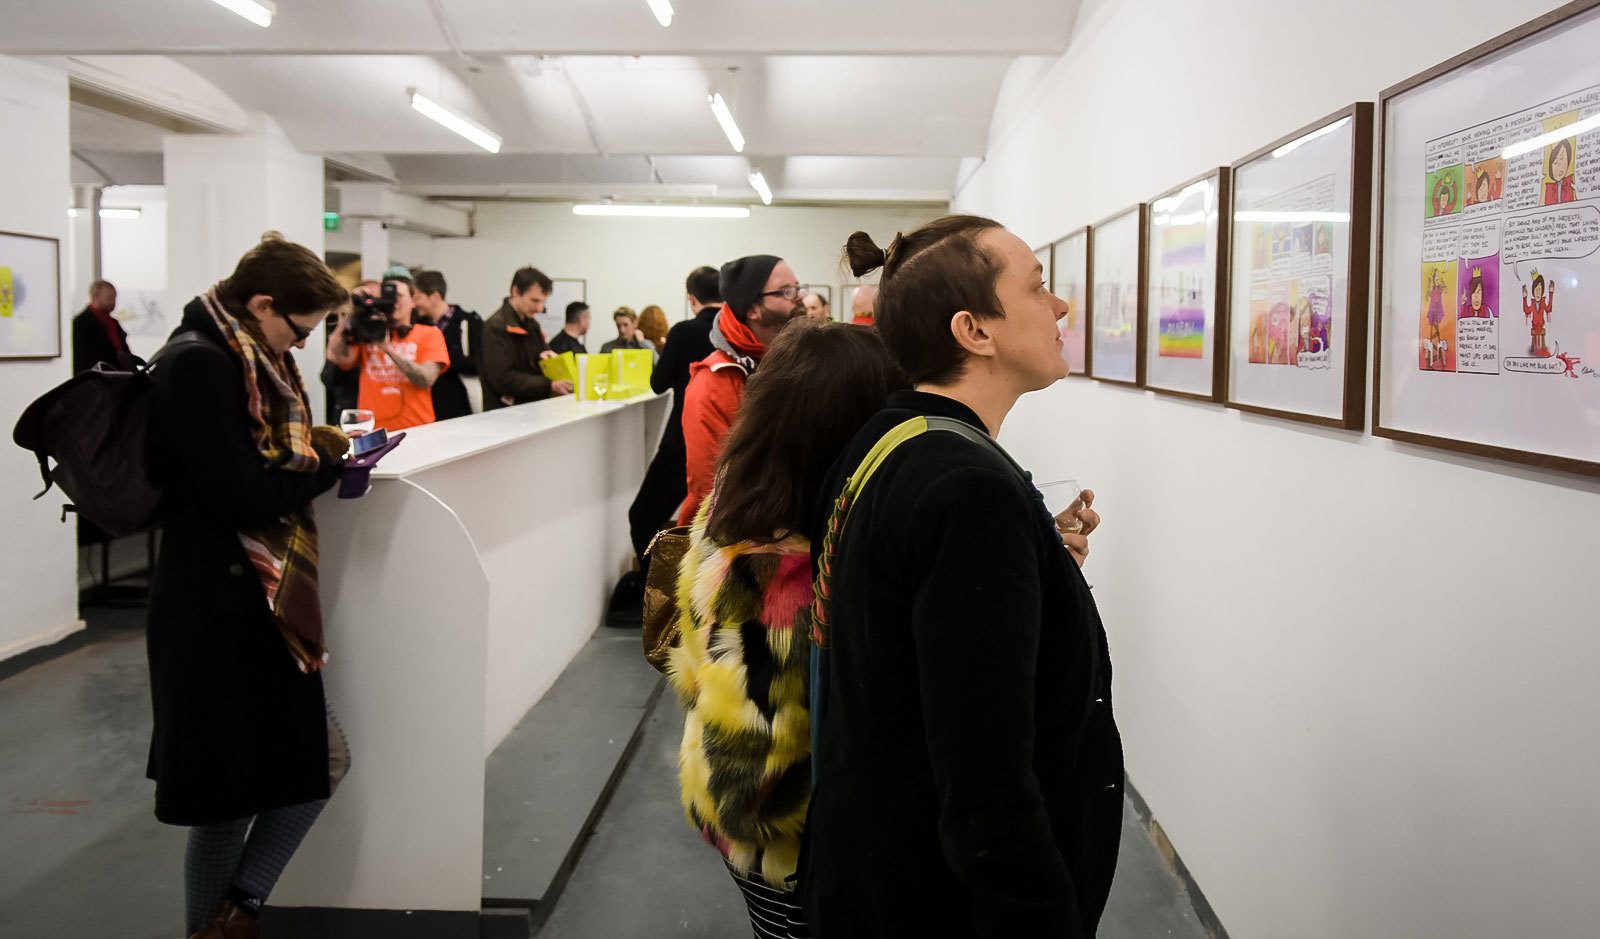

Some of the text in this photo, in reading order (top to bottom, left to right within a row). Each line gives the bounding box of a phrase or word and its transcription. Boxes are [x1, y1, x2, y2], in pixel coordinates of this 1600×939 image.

[1473, 128, 1491, 138] VIEWING
[1492, 125, 1503, 133] WITH
[1510, 113, 1532, 127] MESSAGE
[1534, 110, 1547, 118] FROM
[1548, 103, 1568, 114] QUEEN
[1569, 91, 1600, 108] MARLENE
[1521, 179, 1534, 187] ABOUT
[1516, 219, 1531, 227] SHOULD
[1582, 218, 1599, 226] LIVING
[1574, 234, 1599, 242] LIFESTYLE
[1537, 362, 1548, 370] BLUE
